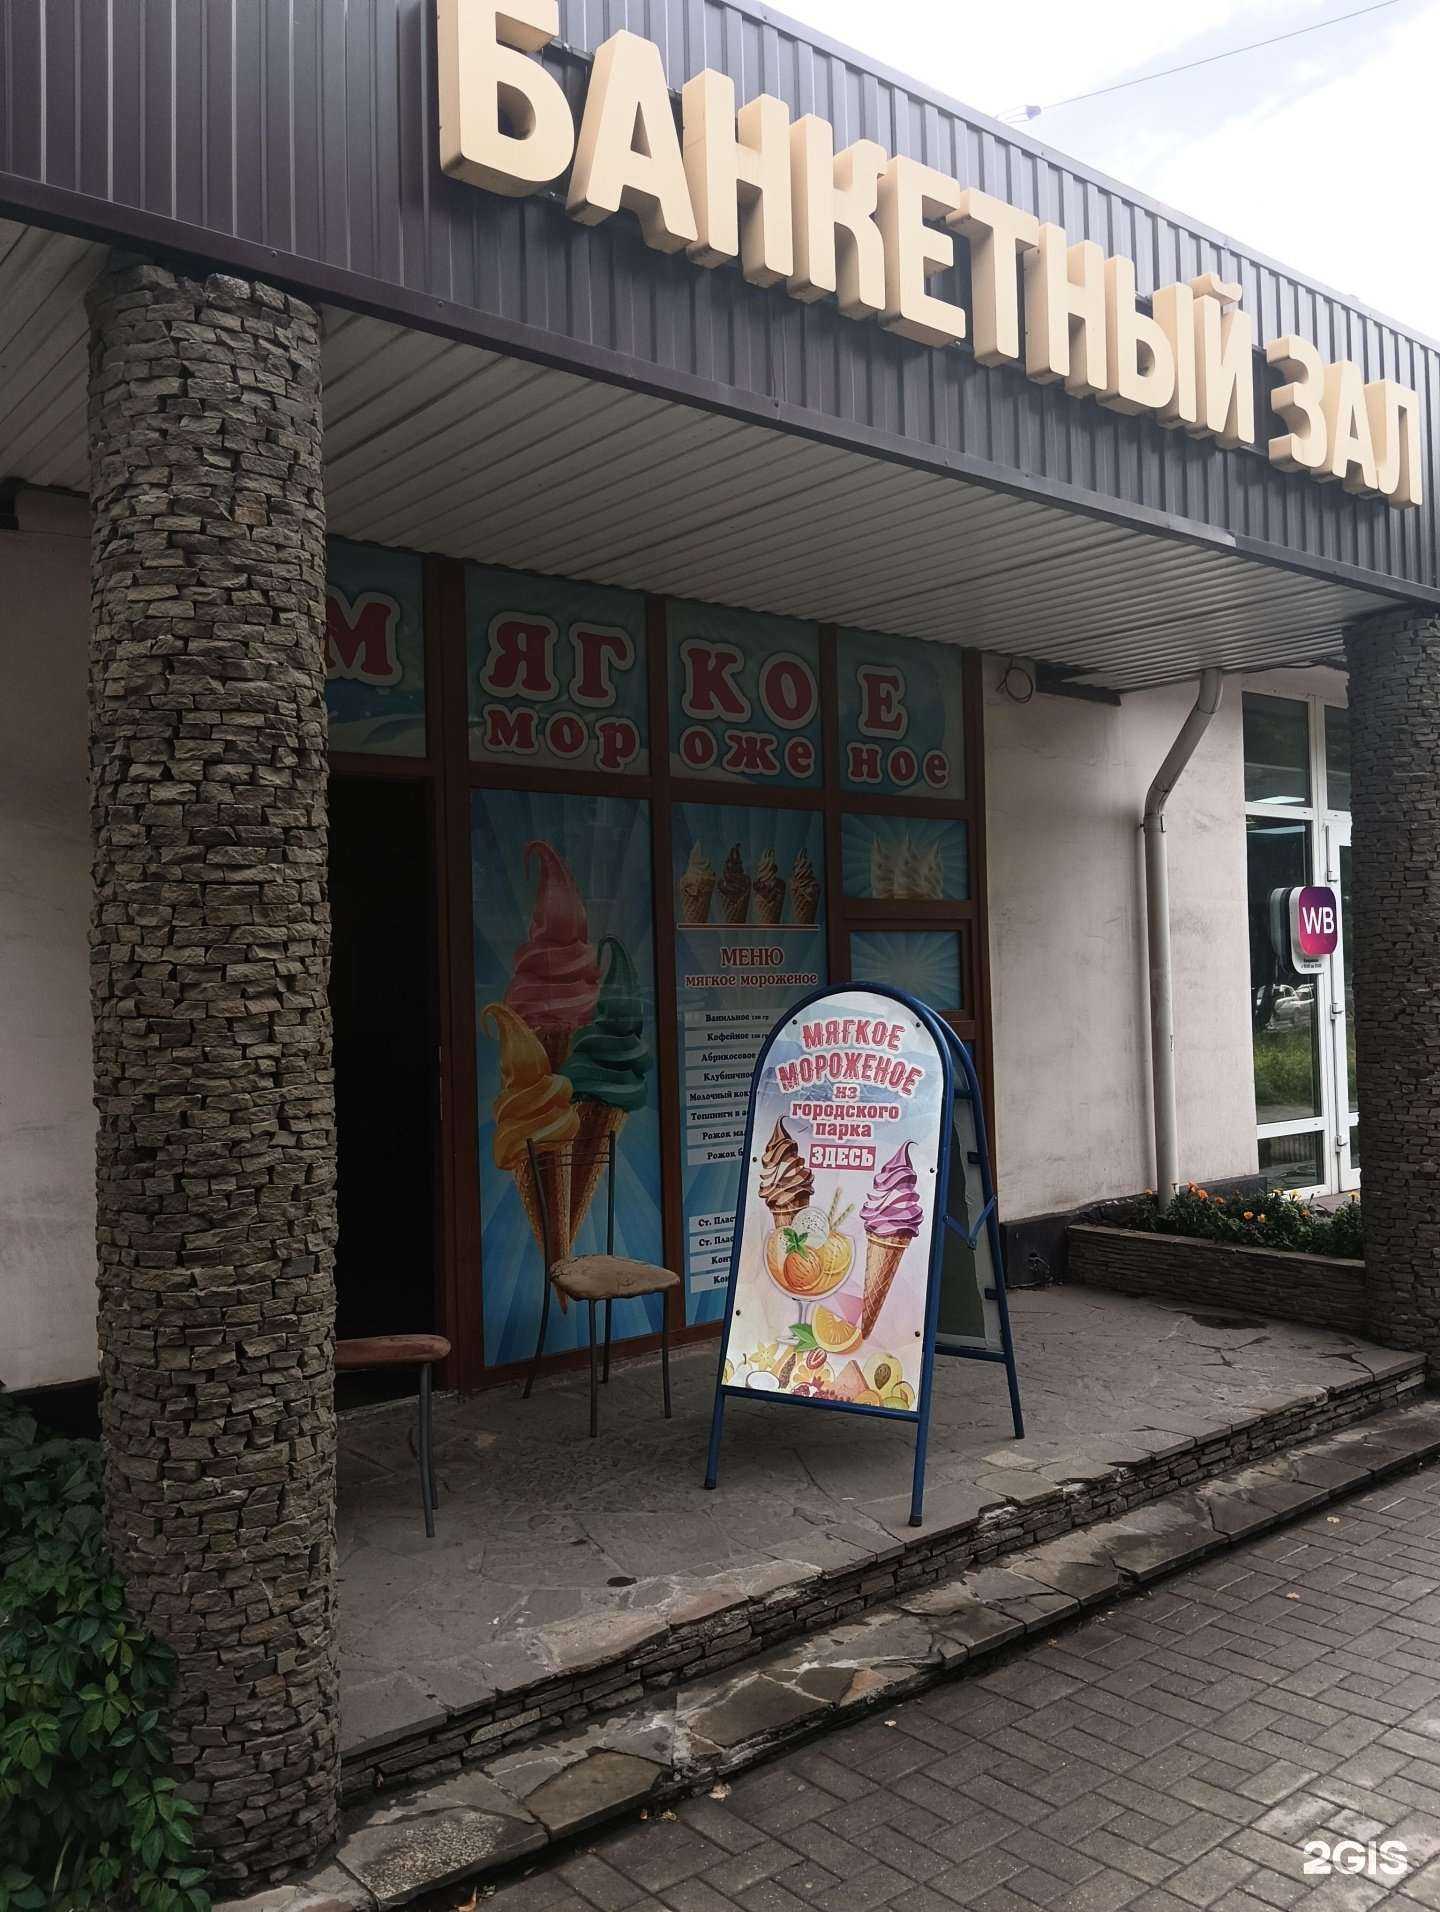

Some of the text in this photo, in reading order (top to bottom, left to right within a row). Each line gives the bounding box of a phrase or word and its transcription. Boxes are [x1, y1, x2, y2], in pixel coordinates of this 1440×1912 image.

[436, 0, 1423, 508] БАНКЕТНЫЙ ЗАЛ
[1302, 906, 1335, 935] WB
[720, 947, 785, 967] МЕНЮ
[685, 972, 818, 988] мягкое мороженое
[802, 1020, 905, 1051] МЯГКОЕ
[778, 1052, 924, 1095] МОРОЖЕНОЕ
[834, 1086, 859, 1099] из
[791, 1102, 900, 1121] городского
[702, 1131, 731, 1141] Рожок
[815, 1122, 873, 1139] парка
[707, 1151, 736, 1160] Рожок
[811, 1147, 875, 1168] ЗДЕСЬ
